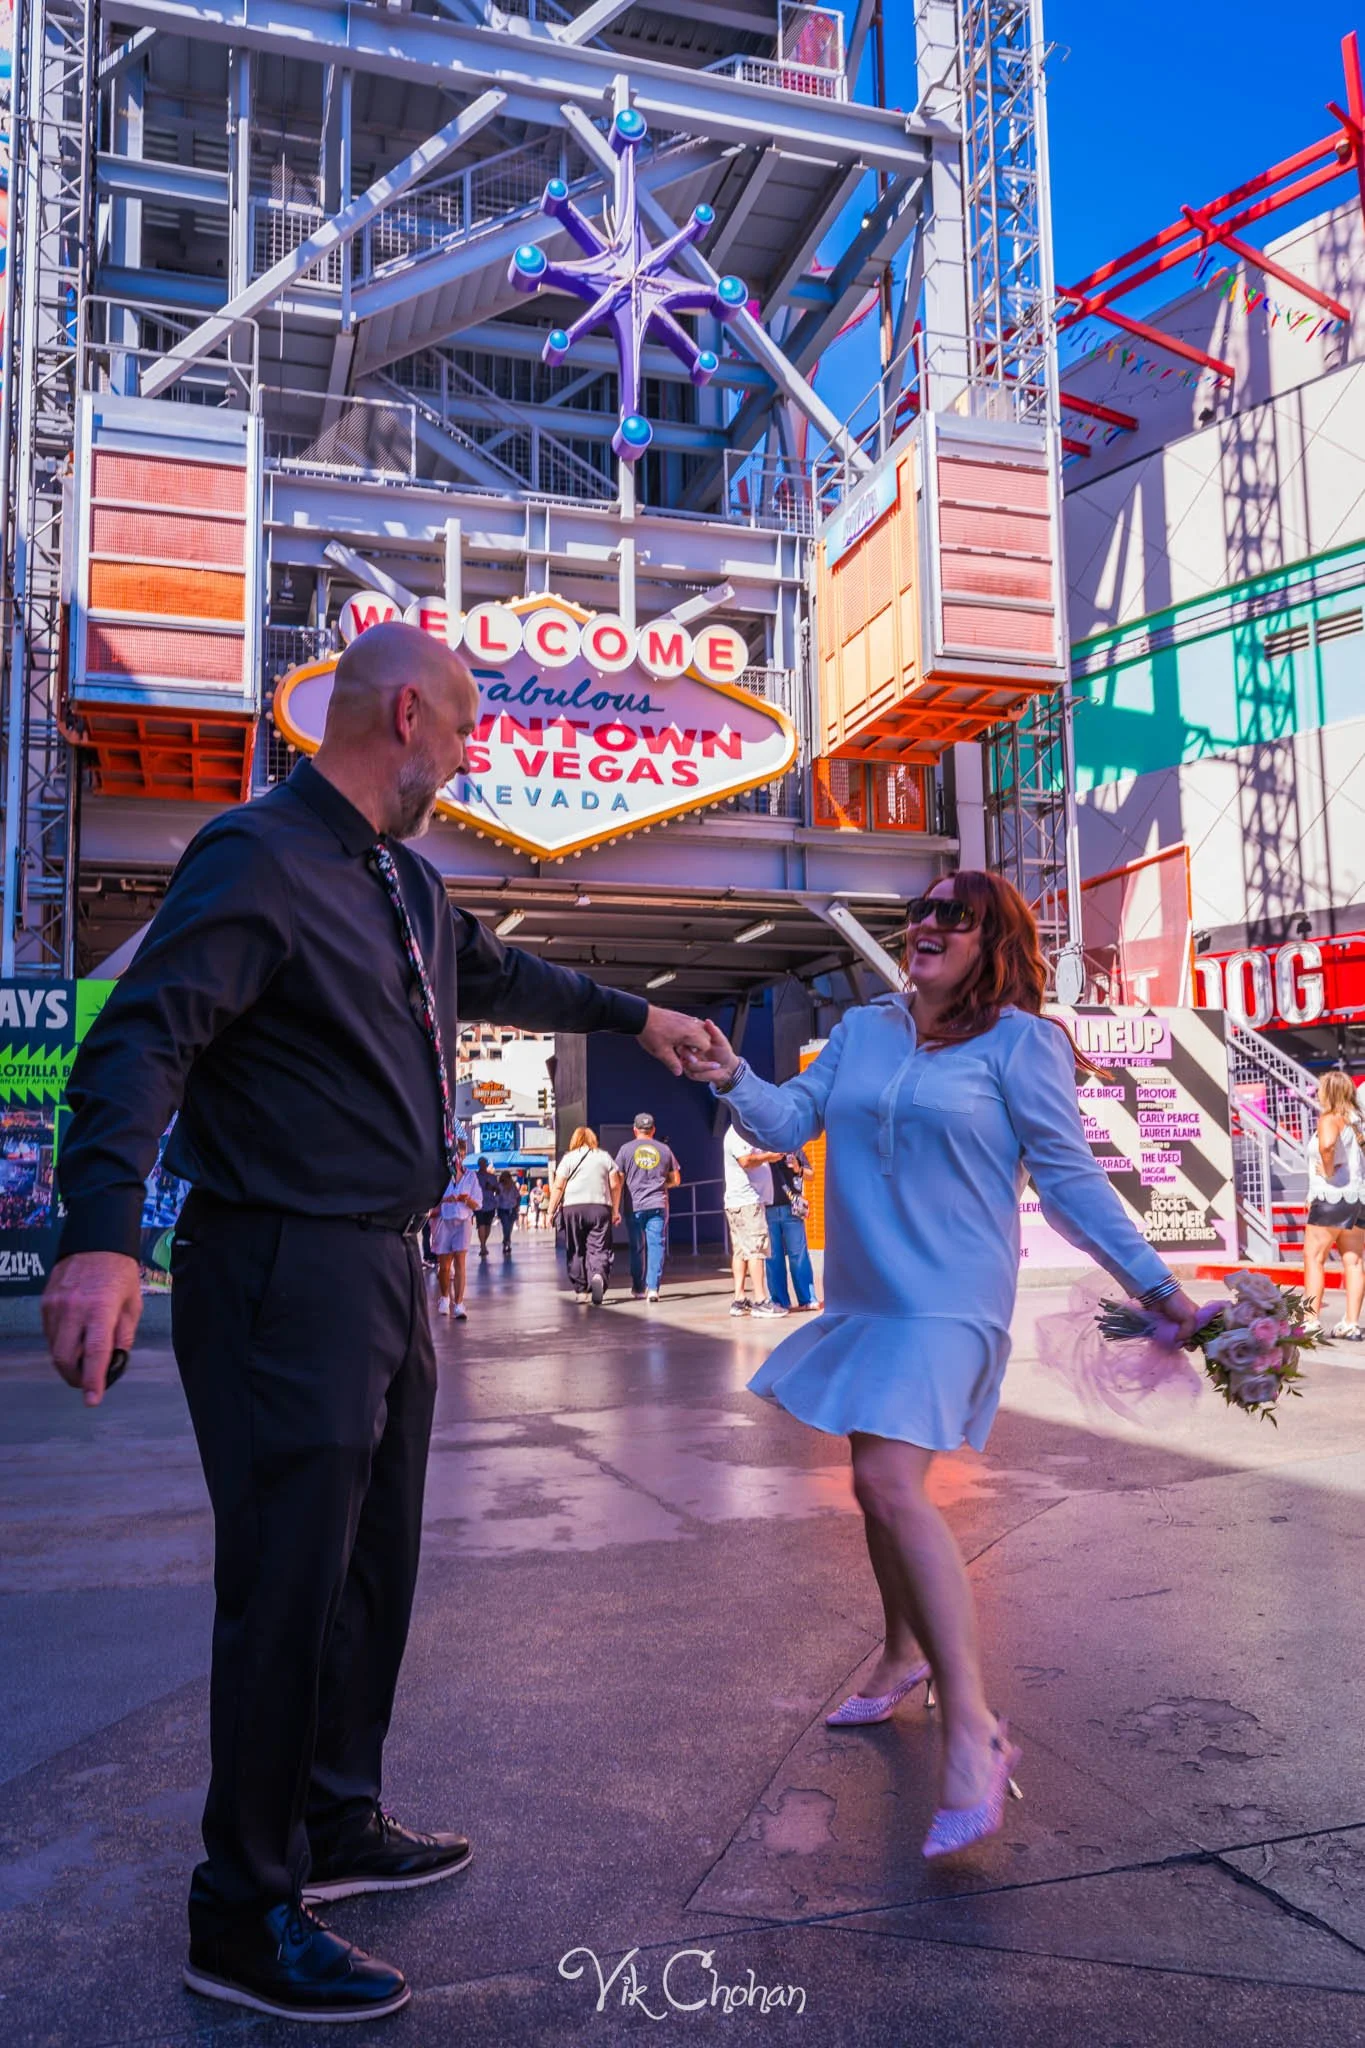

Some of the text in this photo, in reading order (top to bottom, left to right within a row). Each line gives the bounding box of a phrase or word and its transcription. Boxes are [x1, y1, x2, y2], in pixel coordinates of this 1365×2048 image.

[350, 602, 734, 672] WELCOME
[513, 748, 699, 787] VEGAS
[463, 782, 630, 812] NEVADA
[1114, 1058, 1131, 1067] ALL
[1097, 1088, 1123, 1098] BIRGE
[1138, 1088, 1177, 1099] PROTOJE
[1139, 1113, 1200, 1123] CARLY PEARCE
[482, 1122, 512, 1131] NOW
[480, 1131, 514, 1140] OPEN
[1140, 1128, 1171, 1138] LAUREN
[1141, 1153, 1180, 1163] THE USED
[1150, 1199, 1188, 1211] ROCKS
[1143, 1210, 1207, 1229] SUMMER
[1184, 1227, 1217, 1240] SERIES
